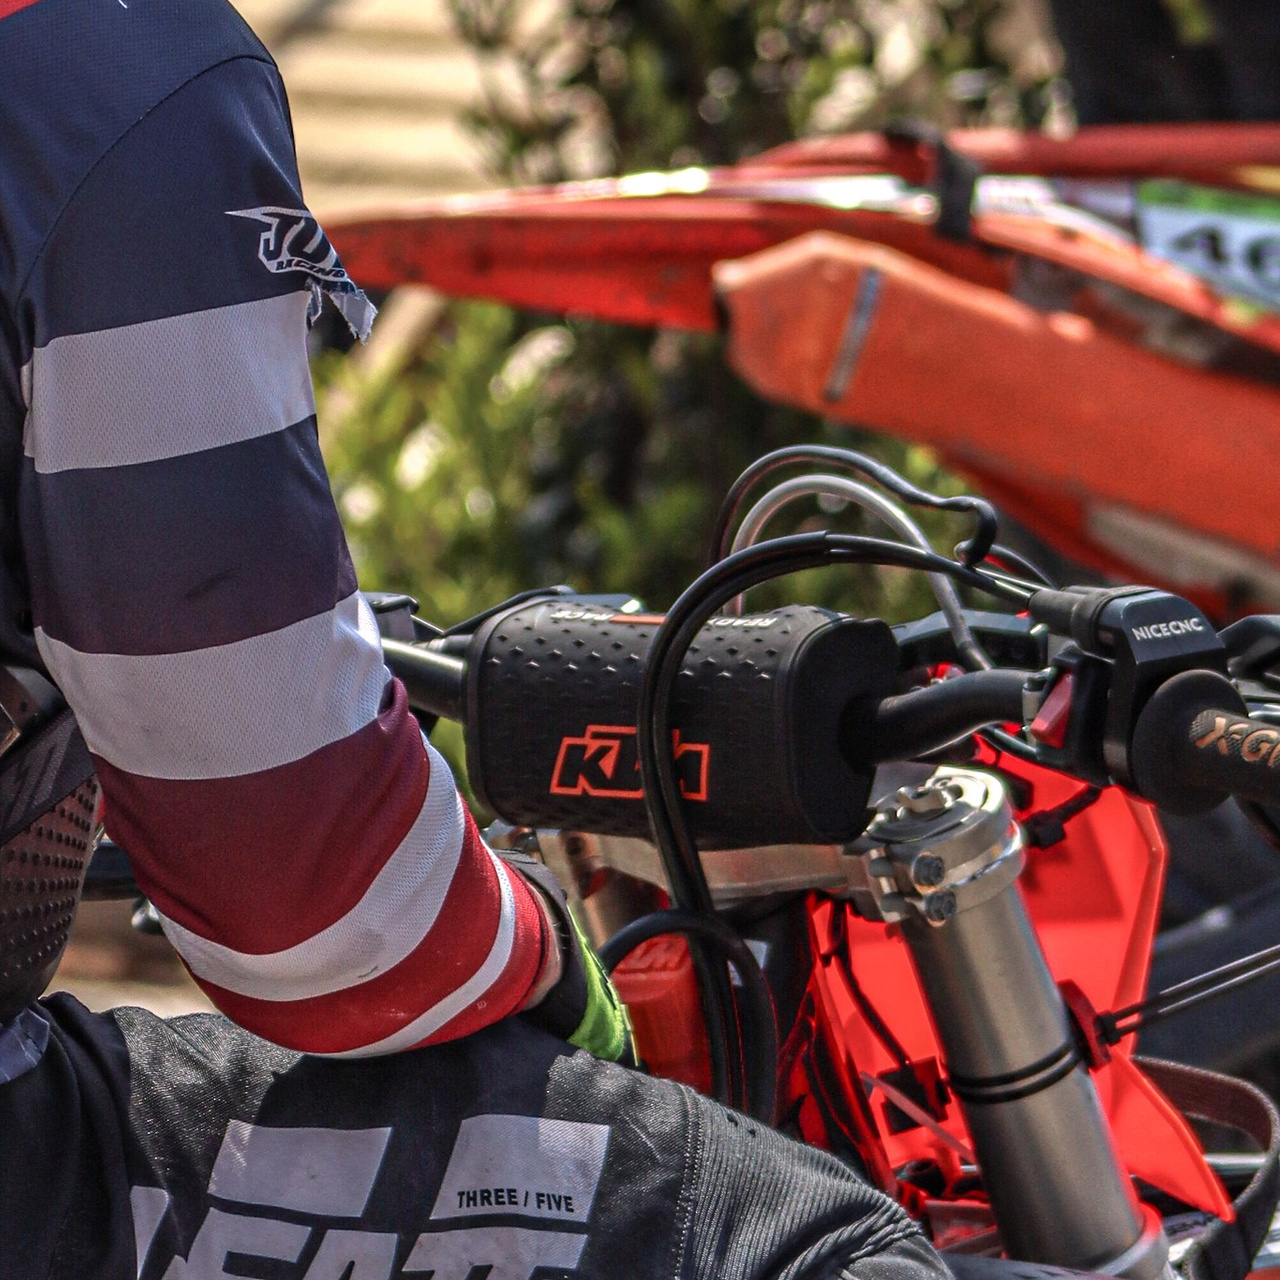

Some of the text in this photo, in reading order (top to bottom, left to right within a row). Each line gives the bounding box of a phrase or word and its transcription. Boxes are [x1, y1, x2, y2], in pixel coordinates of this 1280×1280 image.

[1131, 617, 1206, 642] NICECNC
[458, 1188, 518, 1208] THREE
[535, 1192, 575, 1213] FIVE
